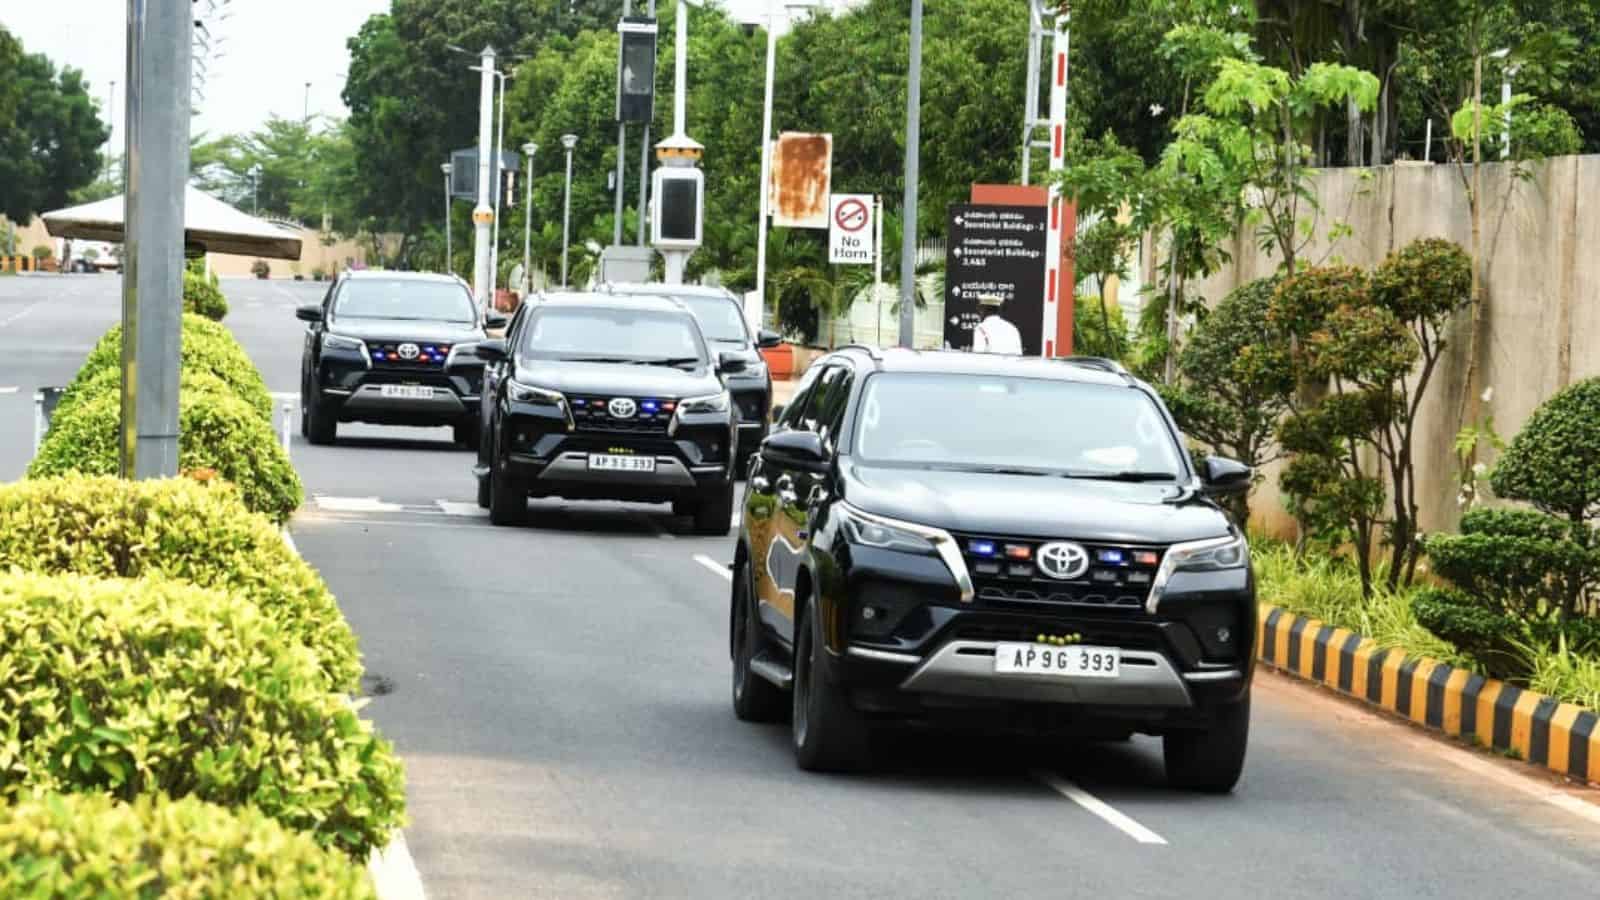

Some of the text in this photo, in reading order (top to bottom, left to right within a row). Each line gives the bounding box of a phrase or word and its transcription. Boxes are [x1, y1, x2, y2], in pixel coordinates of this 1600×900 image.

[964, 221, 1001, 230] Secretariat
[1003, 221, 1034, 232] Buildings
[841, 236, 861, 247] No
[833, 248, 868, 259] Horn
[964, 247, 1005, 257] Secretariat
[1006, 248, 1040, 259] Buildings
[1079, 650, 1115, 673] 393
